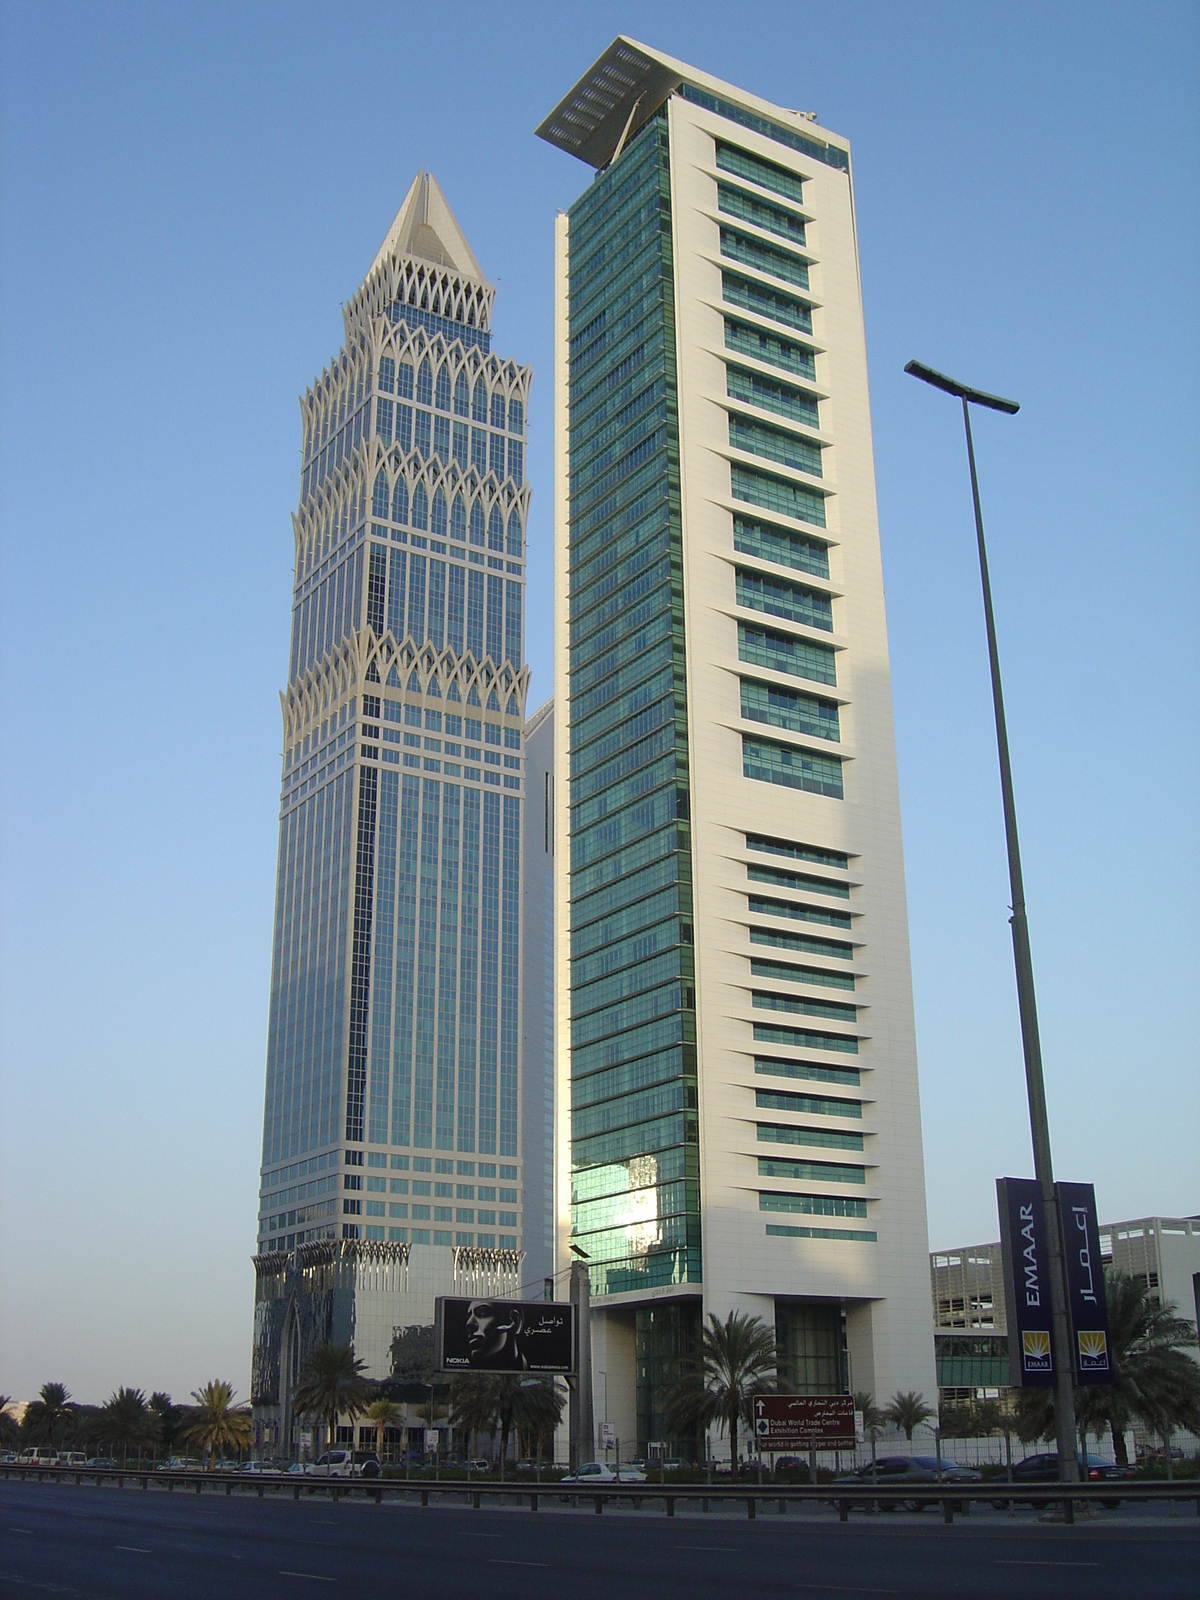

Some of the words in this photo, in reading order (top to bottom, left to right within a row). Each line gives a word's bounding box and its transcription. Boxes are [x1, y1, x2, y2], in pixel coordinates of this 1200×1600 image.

[1020, 1203, 1041, 1307] EMAAR
[539, 1316, 563, 1327] تواصل
[800, 1427, 824, 1435] Complex
[791, 1440, 809, 1448] getting
